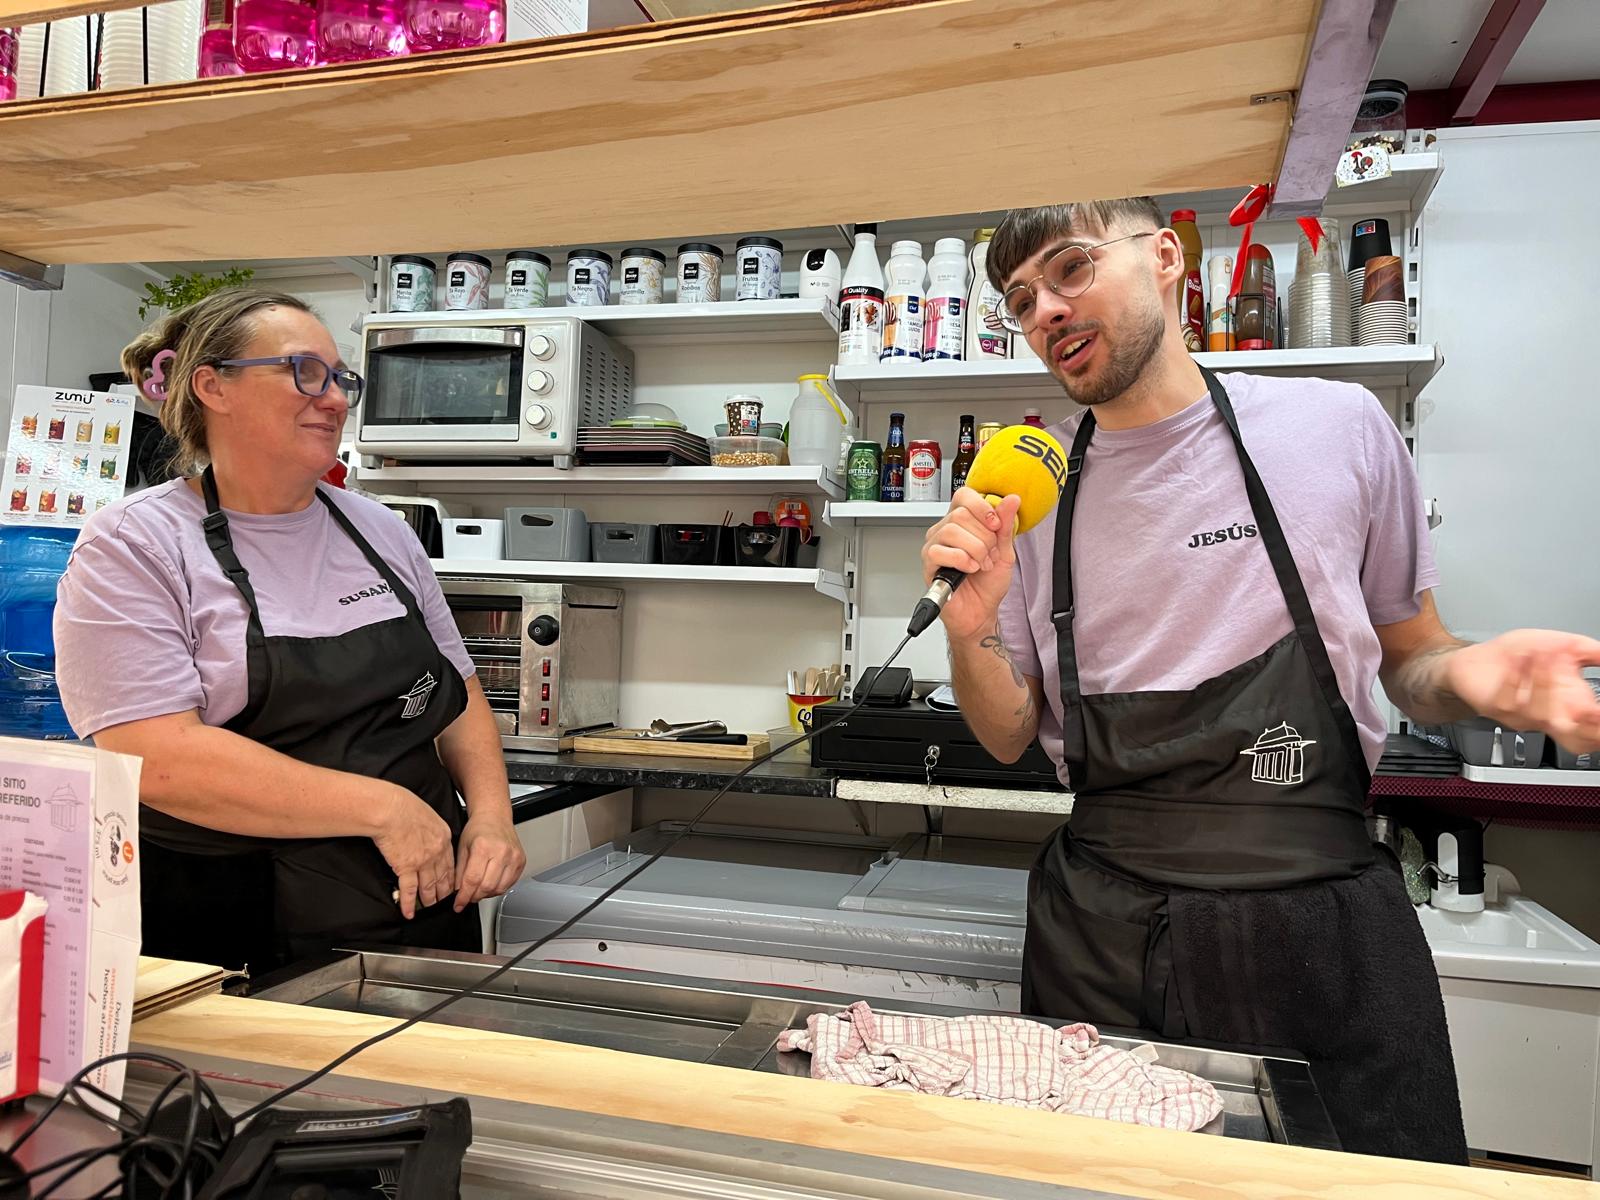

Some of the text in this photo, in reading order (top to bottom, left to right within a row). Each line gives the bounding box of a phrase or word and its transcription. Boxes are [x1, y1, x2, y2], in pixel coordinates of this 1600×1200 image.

[848, 287, 869, 295] Quality
[1188, 522, 1257, 548] JESÚS
[3, 777, 26, 790] SITIO
[102, 968, 110, 1010] hechos
[111, 1001, 122, 1056] Delicioso
[97, 1026, 105, 1085] momnto
